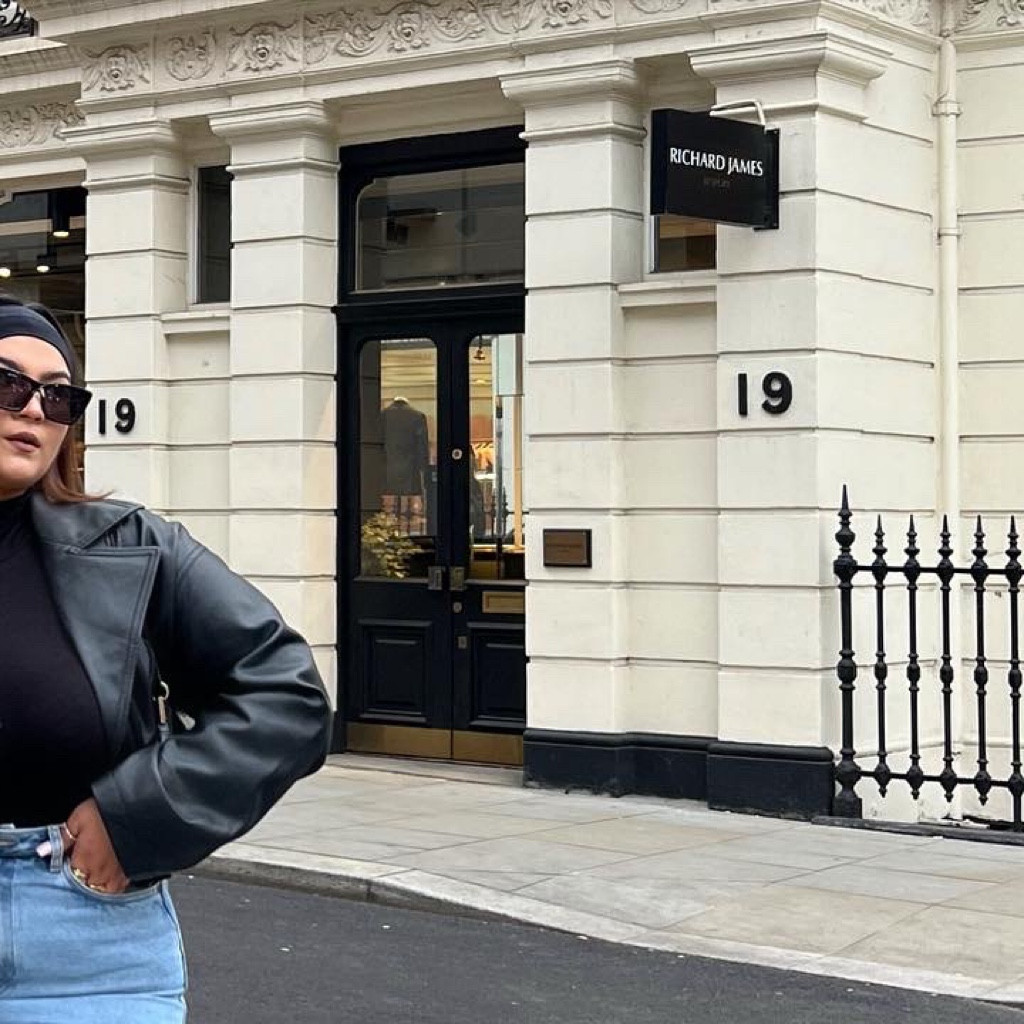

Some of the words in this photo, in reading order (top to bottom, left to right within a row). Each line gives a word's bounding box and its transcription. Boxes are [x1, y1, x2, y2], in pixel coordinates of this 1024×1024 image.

[670, 147, 725, 170] RICHARD
[728, 157, 763, 176] JAMES
[737, 370, 793, 417] 19
[98, 397, 136, 435] 19
